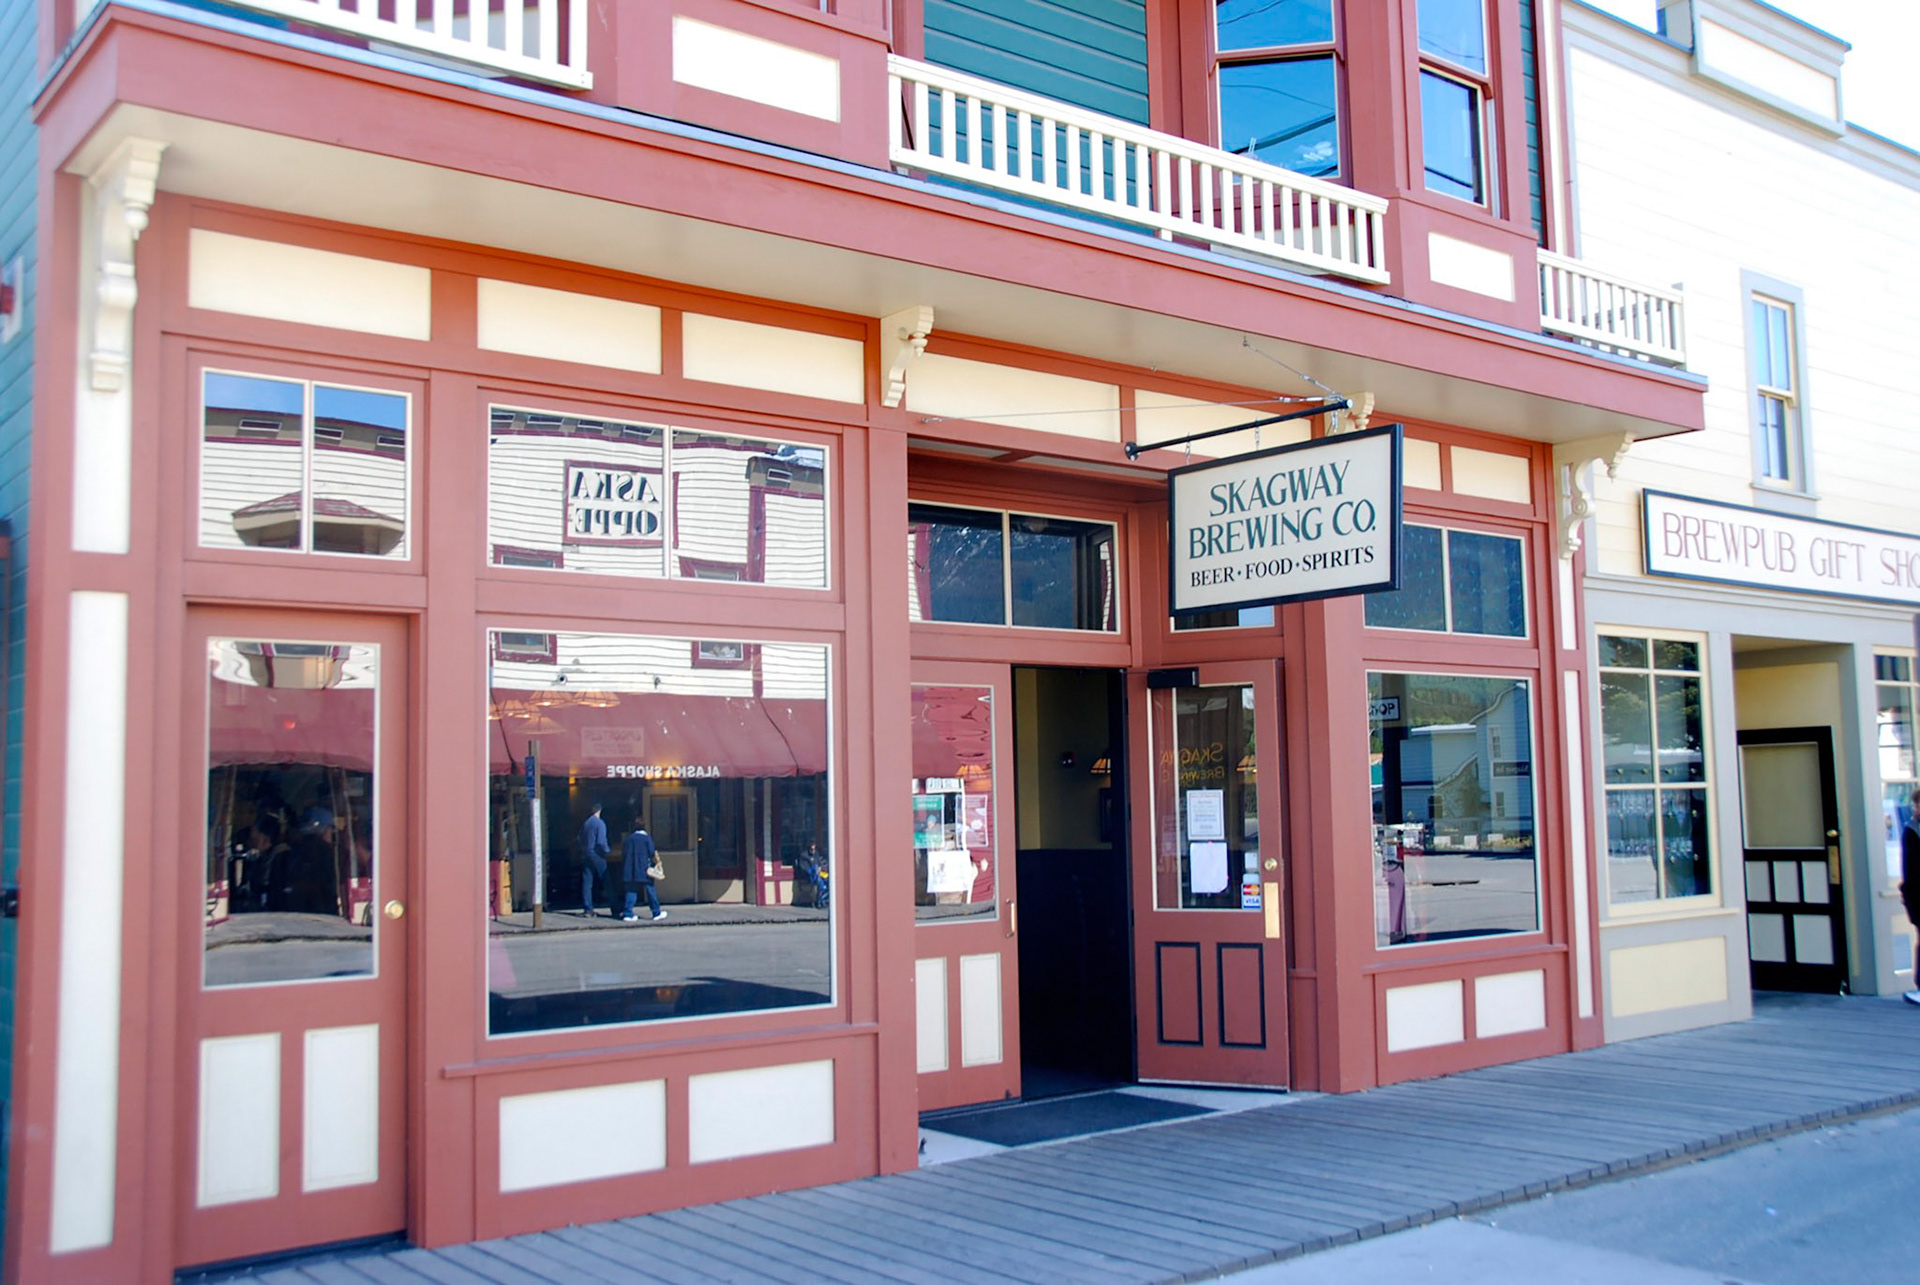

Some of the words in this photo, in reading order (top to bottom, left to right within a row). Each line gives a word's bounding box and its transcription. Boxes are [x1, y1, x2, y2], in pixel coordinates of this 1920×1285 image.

[1209, 460, 1350, 517] SKAGWAY
[1189, 506, 1323, 559] BREWING
[1332, 498, 1376, 536] CO.
[1662, 512, 1796, 573] BREWPUB
[1809, 537, 1866, 582] GIFT
[1191, 566, 1235, 587] BEER
[1246, 558, 1293, 580] FOOD
[1302, 545, 1374, 571] SPIRITS
